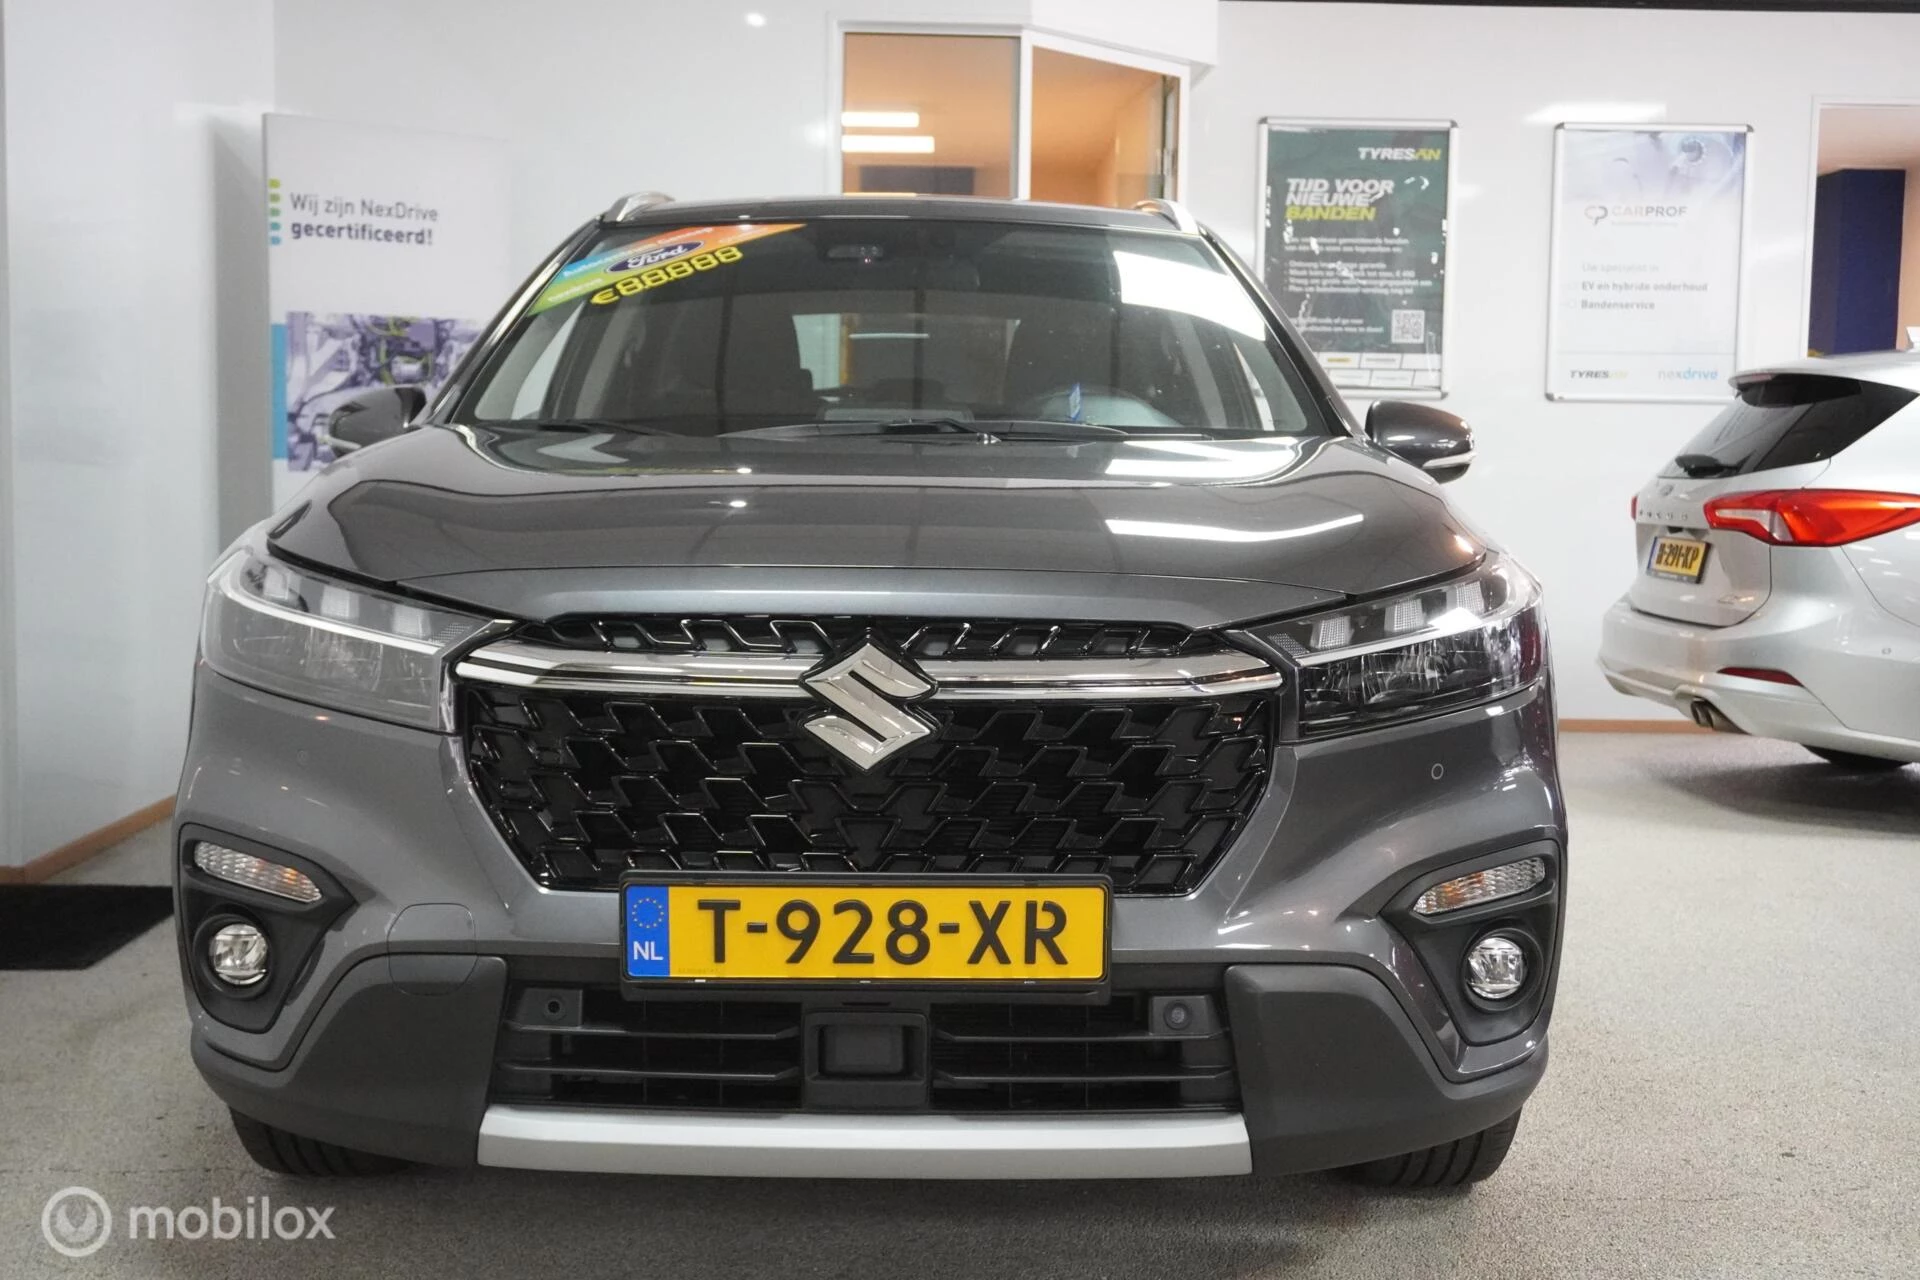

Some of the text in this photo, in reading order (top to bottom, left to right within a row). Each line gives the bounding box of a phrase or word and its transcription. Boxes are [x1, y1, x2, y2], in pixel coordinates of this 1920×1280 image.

[1286, 178, 1394, 194] TIJD VOOR
[1285, 191, 1371, 206] NIEUWE
[290, 192, 439, 222] Wij zijn NexDrive
[1285, 206, 1377, 220] BANDEN
[1611, 205, 1688, 218] CARPROF
[290, 222, 434, 246] gecertificeerd!
[627, 245, 688, 268] Ford
[1581, 280, 1708, 295] EV en hybride onderhoud
[1581, 299, 1655, 310] Bandenservice
[1658, 366, 1719, 381] nexdrive
[697, 899, 1068, 965] T-928-XR
[633, 941, 663, 961] NL
